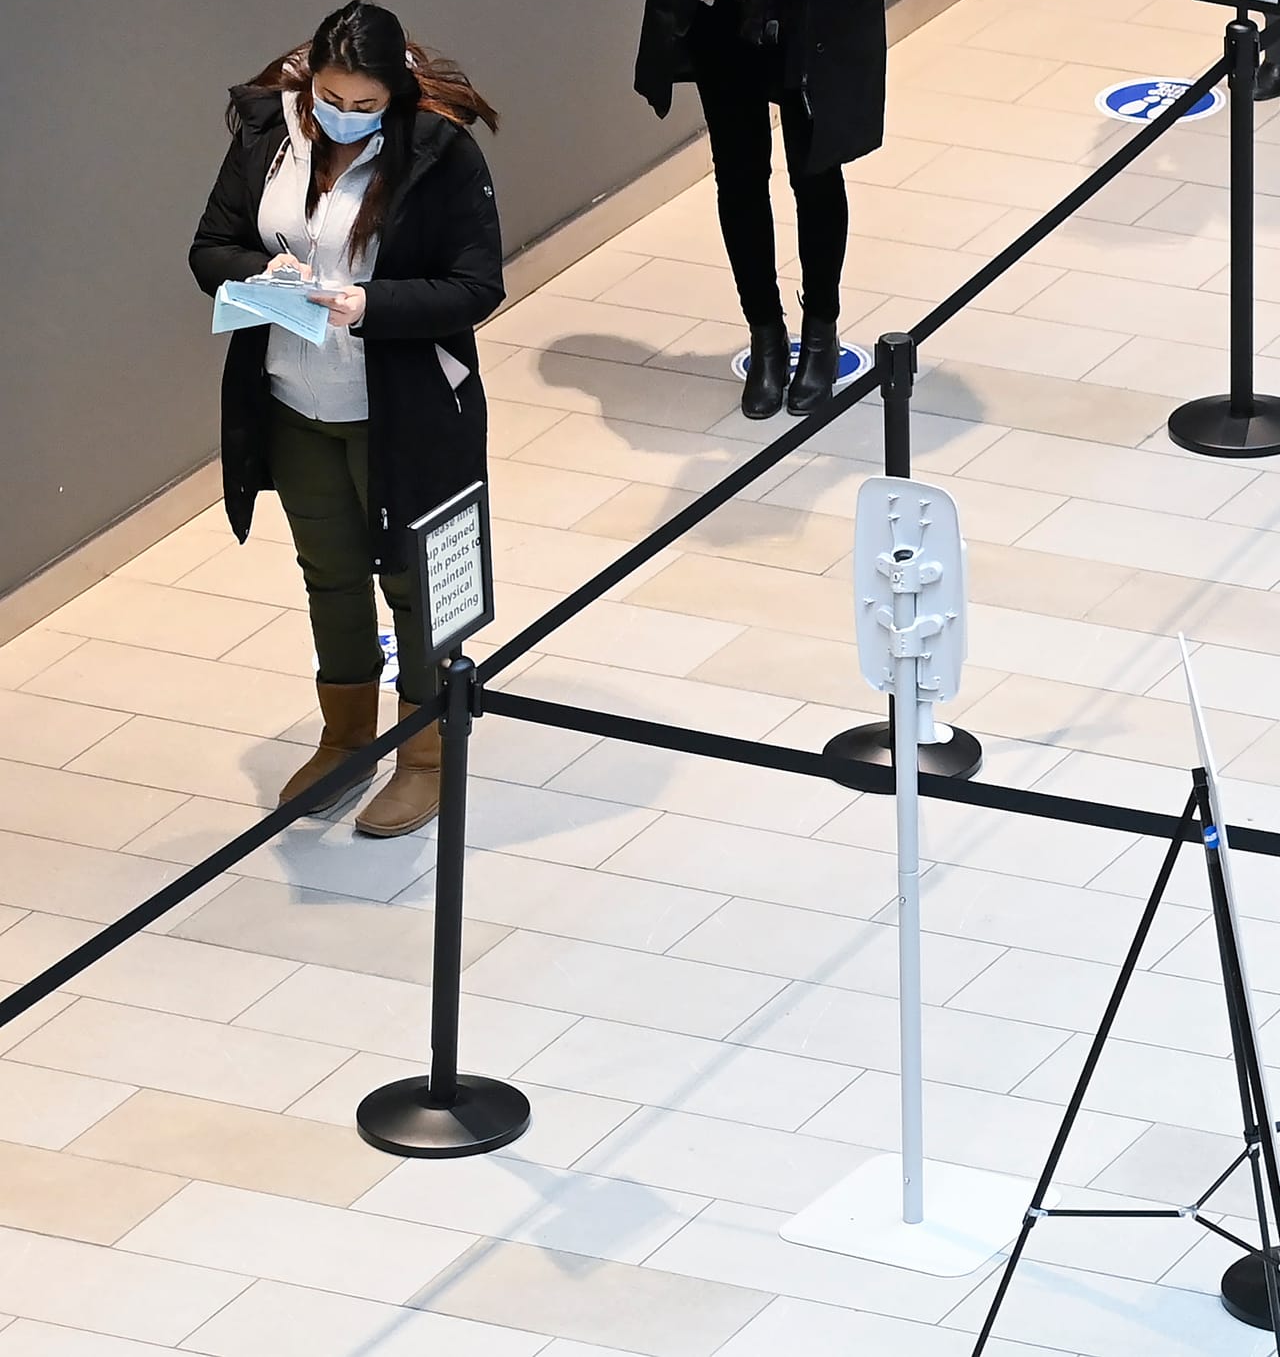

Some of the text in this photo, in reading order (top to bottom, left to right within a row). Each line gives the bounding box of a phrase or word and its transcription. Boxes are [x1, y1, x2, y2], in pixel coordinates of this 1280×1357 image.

[441, 518, 475, 551] aligned
[429, 561, 443, 577] ith
[445, 544, 470, 570] posts
[433, 560, 473, 594] maintain
[435, 575, 473, 614] physical
[432, 593, 479, 631] distancing
